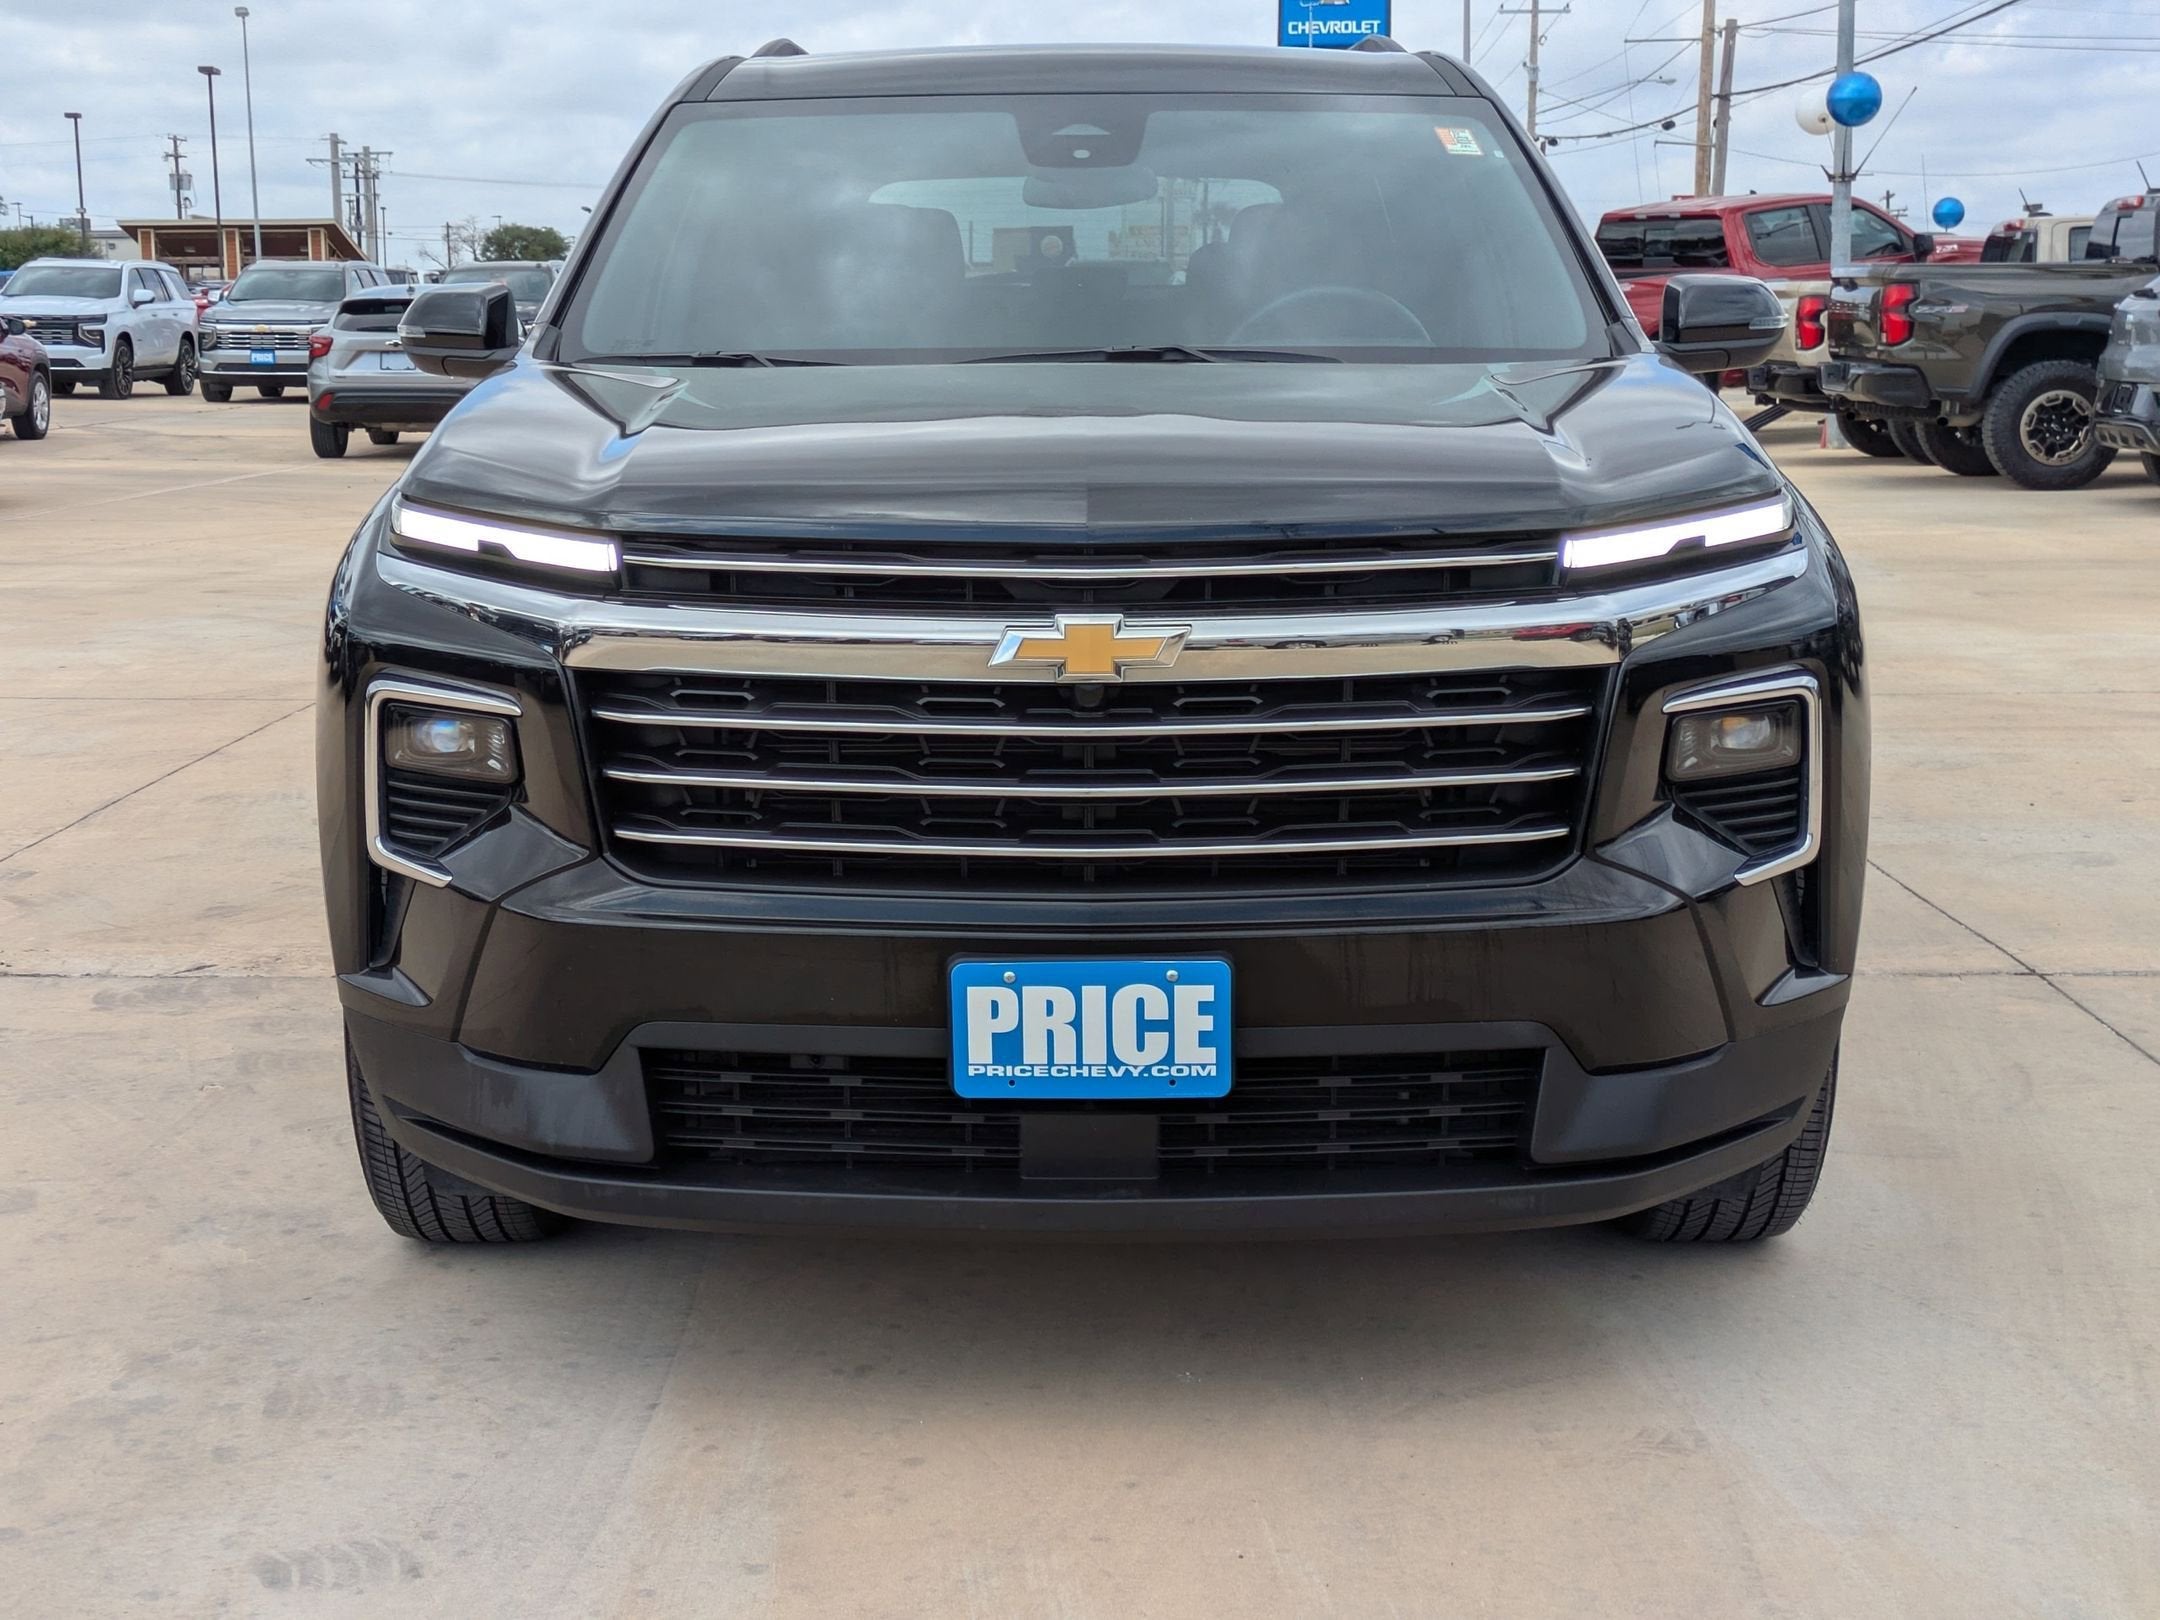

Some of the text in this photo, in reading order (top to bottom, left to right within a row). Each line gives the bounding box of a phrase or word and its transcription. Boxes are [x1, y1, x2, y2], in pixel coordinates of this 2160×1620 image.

[1287, 20, 1381, 35] CHEVROLET
[966, 984, 1217, 1065] PRICE
[968, 1065, 1217, 1077] PRICECHEVY.COM
